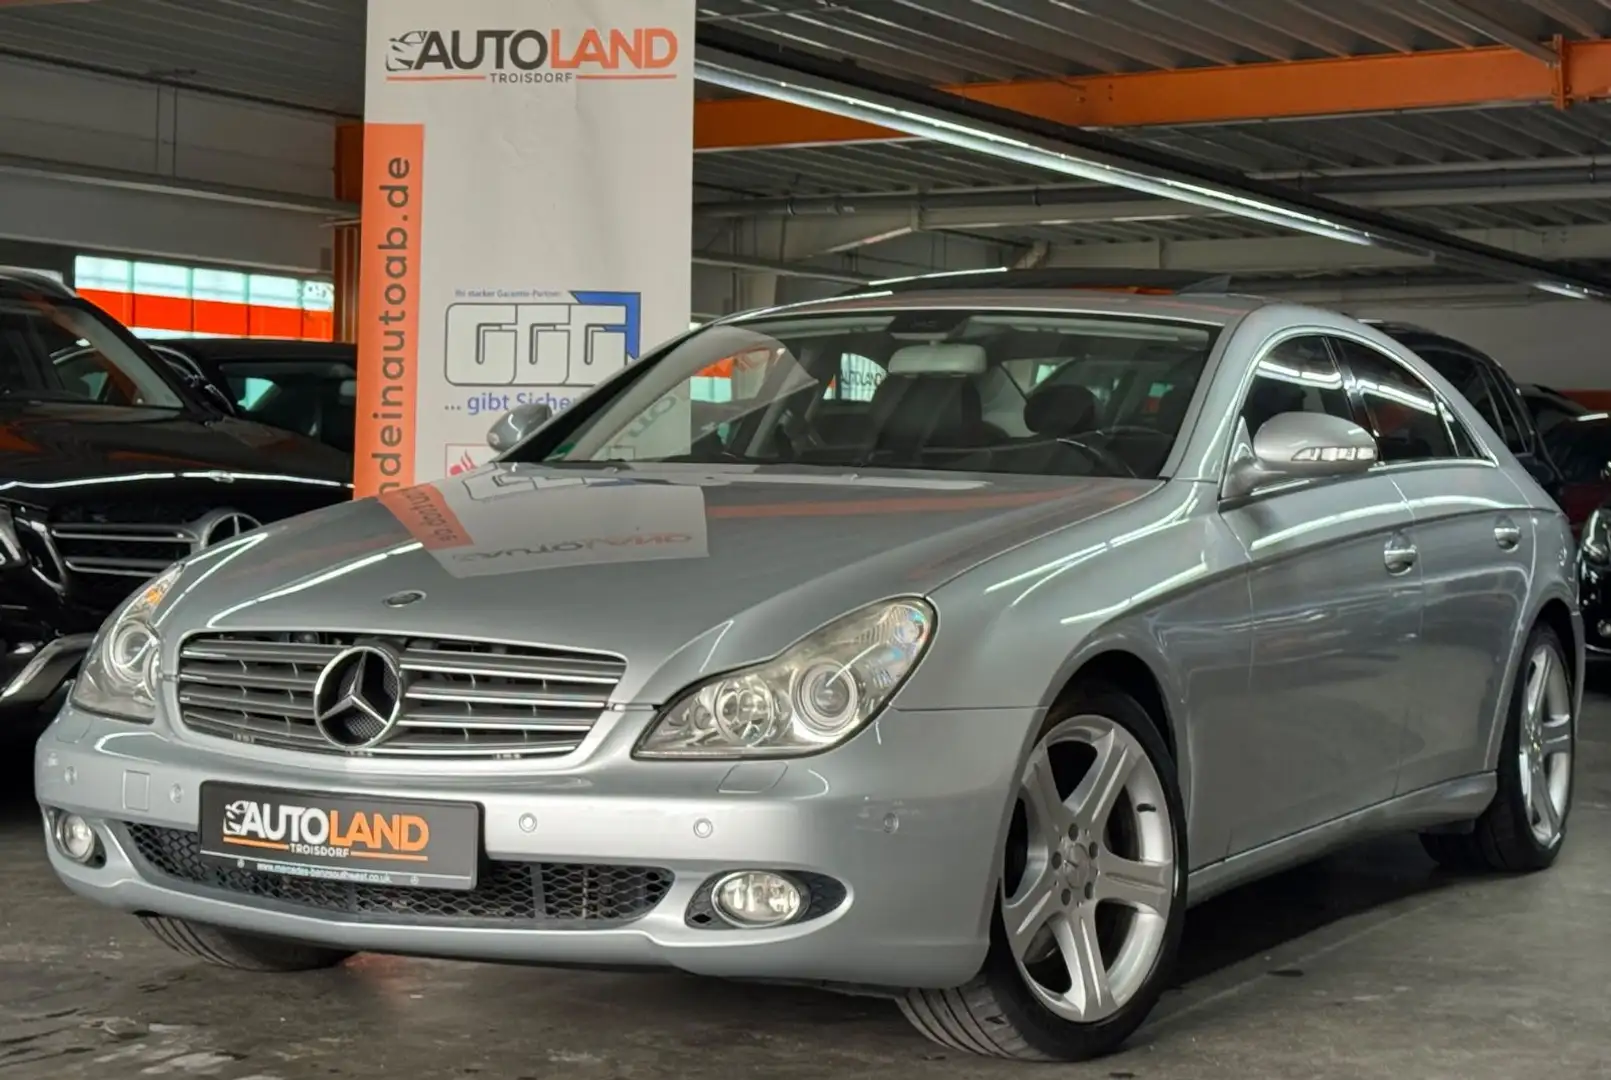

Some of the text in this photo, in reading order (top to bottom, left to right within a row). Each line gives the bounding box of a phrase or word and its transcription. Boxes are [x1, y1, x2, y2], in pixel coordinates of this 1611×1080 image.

[414, 28, 679, 71] AUTOLAND
[490, 72, 574, 84] TROISDORF
[467, 392, 510, 416] gibt
[241, 801, 429, 851] AUTOLAND
[290, 842, 350, 858] TROISDORF
